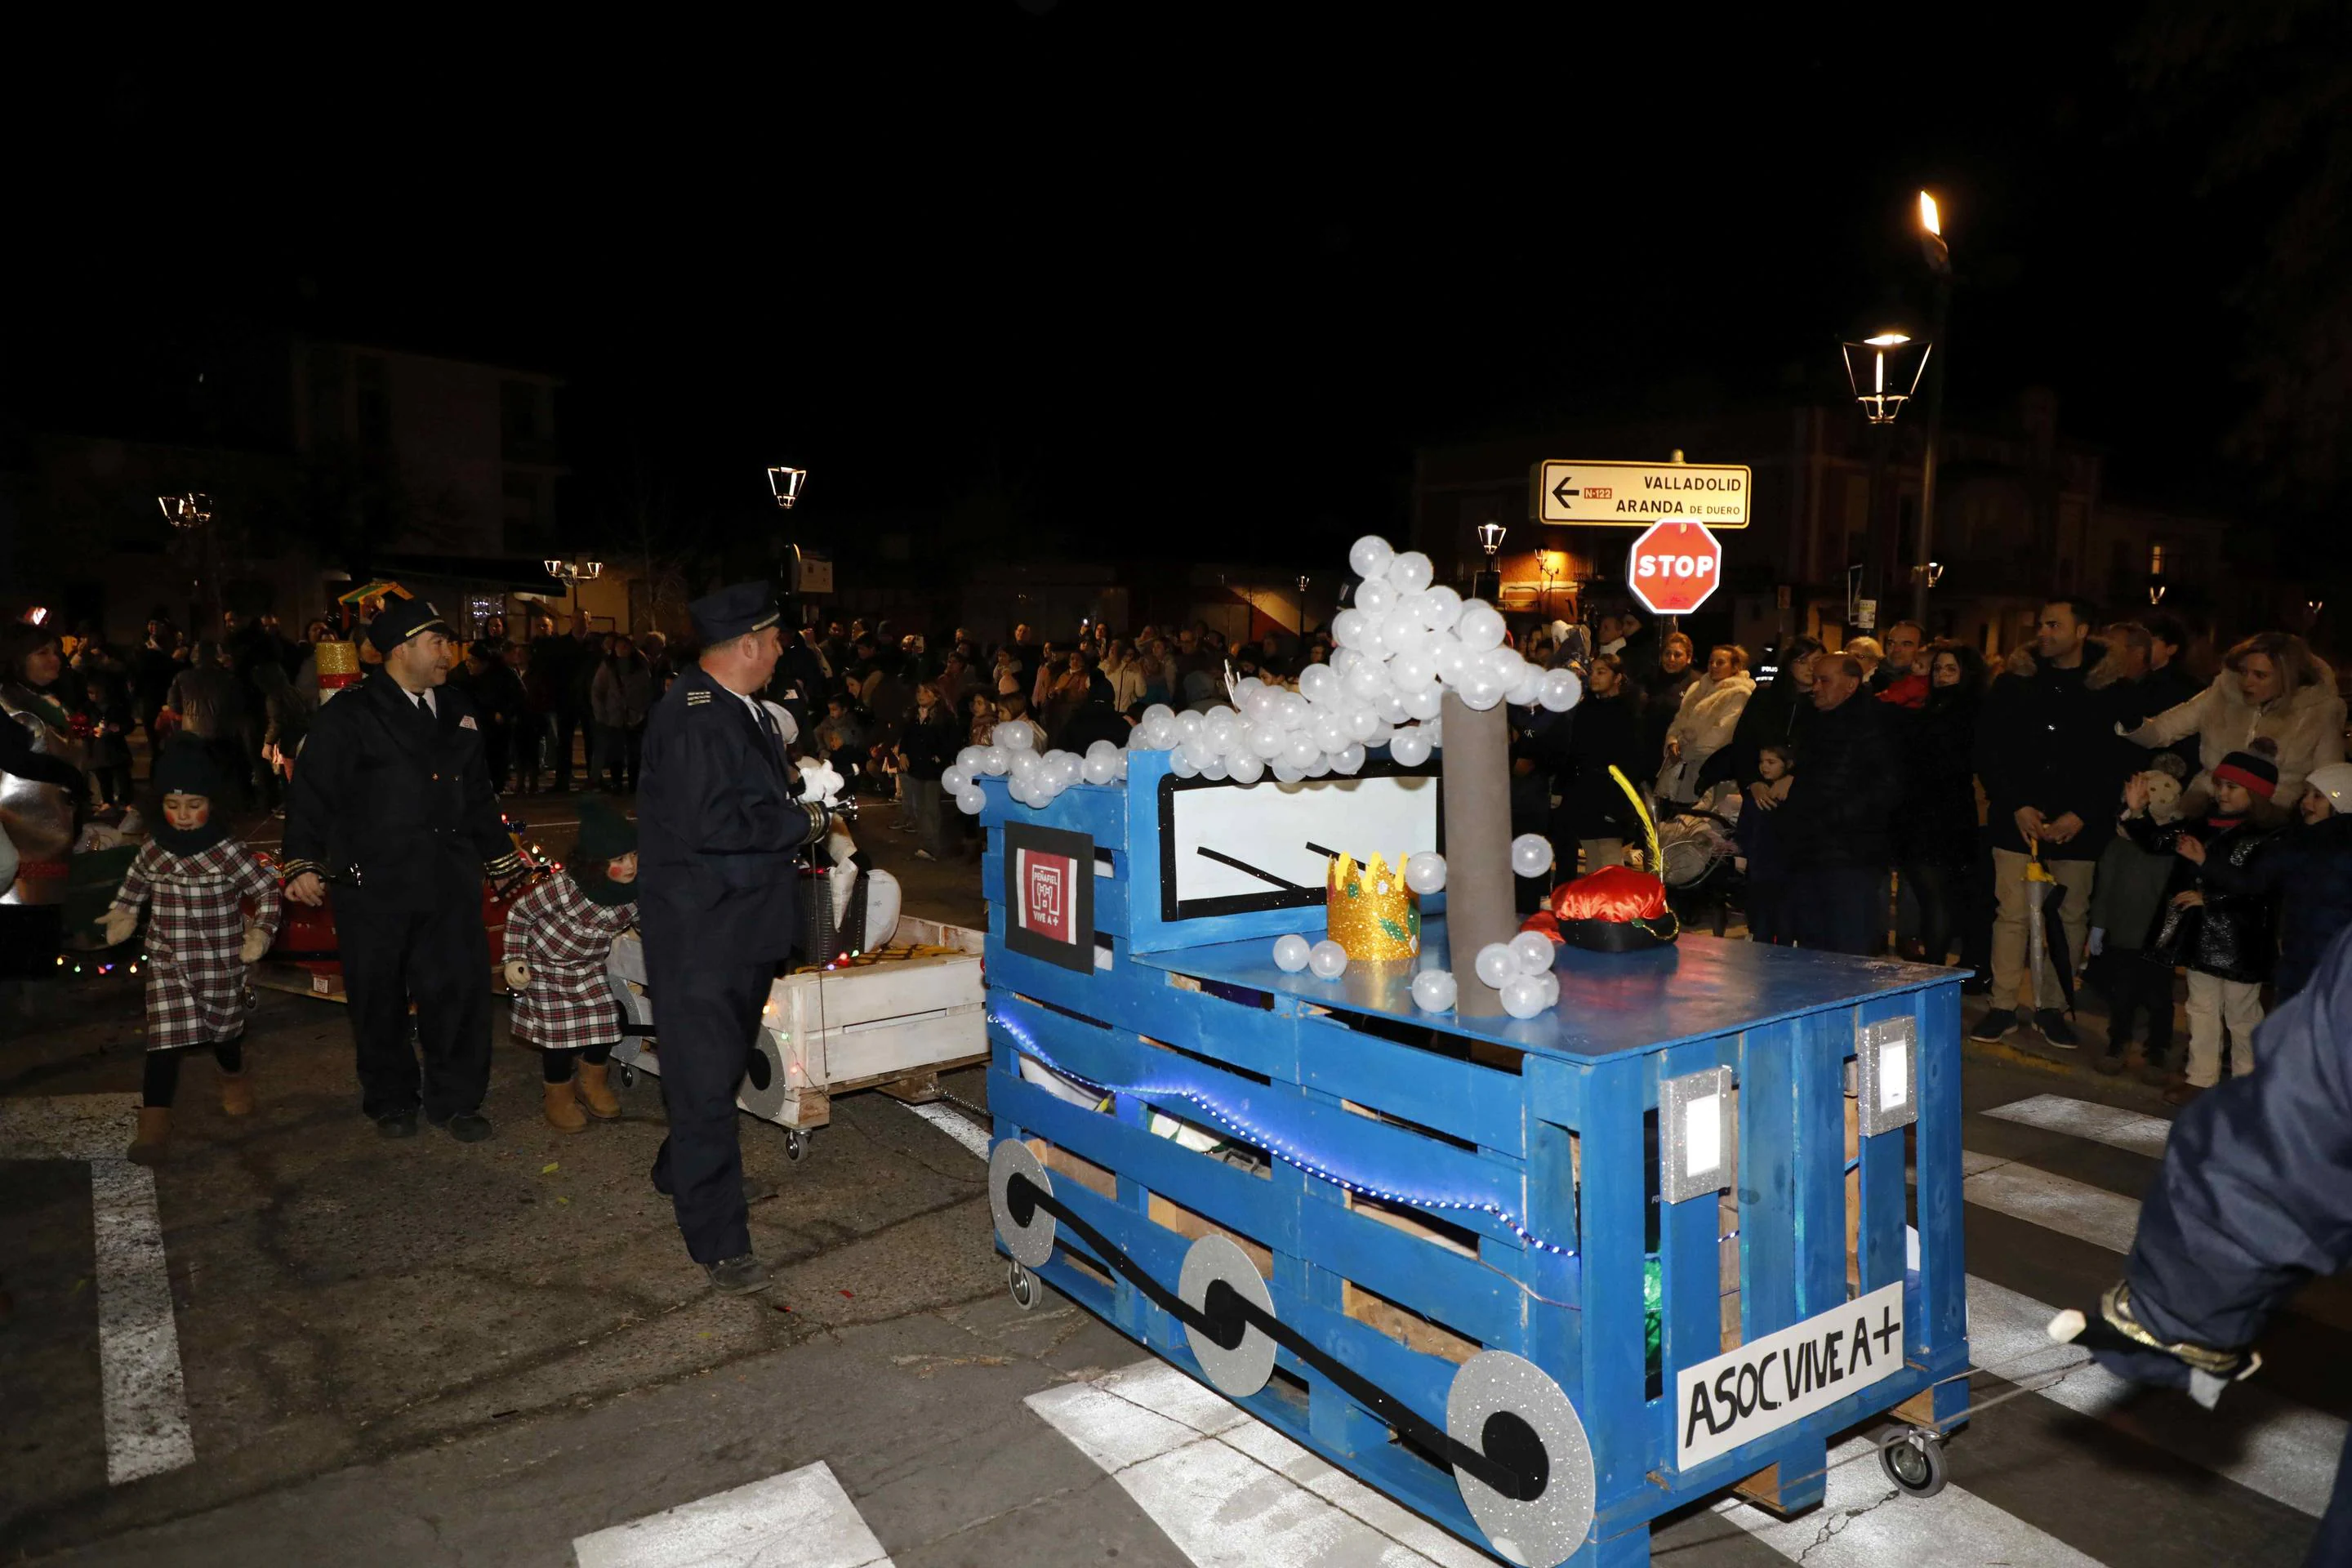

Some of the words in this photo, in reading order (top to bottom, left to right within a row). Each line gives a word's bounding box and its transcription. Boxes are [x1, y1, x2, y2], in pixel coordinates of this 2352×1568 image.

[1644, 476, 1741, 492] VALLADOLID
[1615, 500, 1684, 514] ARANDA
[1690, 506, 1703, 514] DE
[1707, 506, 1740, 515] DUERO
[1638, 555, 1713, 577] STOP
[1034, 870, 1058, 884] PEÑAFIEL
[1032, 911, 1045, 923] VIVE
[1685, 1351, 1782, 1449] ASOC.
[1783, 1330, 1843, 1402] VIVE
